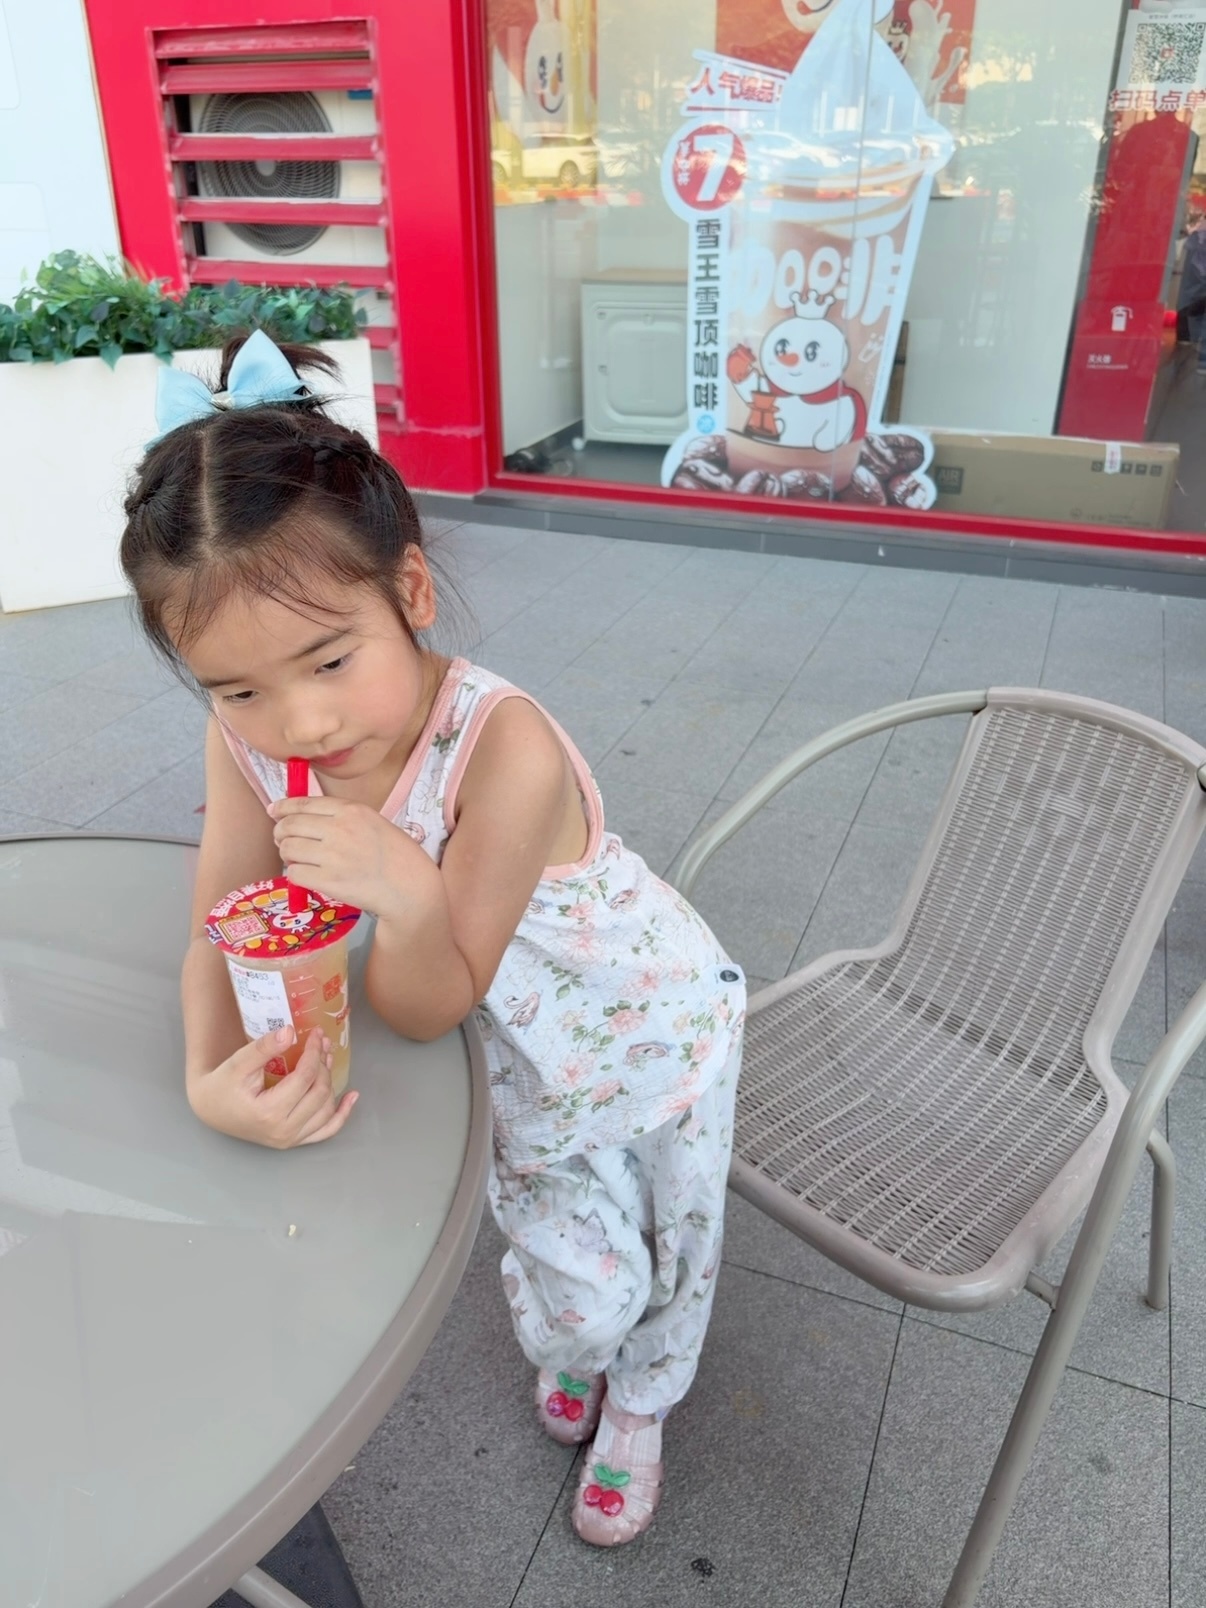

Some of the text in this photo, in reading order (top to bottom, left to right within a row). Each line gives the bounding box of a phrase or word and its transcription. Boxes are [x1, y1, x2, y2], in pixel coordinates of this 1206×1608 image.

[1109, 89, 1206, 111] 扫码点单
[693, 134, 735, 203] 7
[693, 217, 722, 412] 雪王雪顶咖啡
